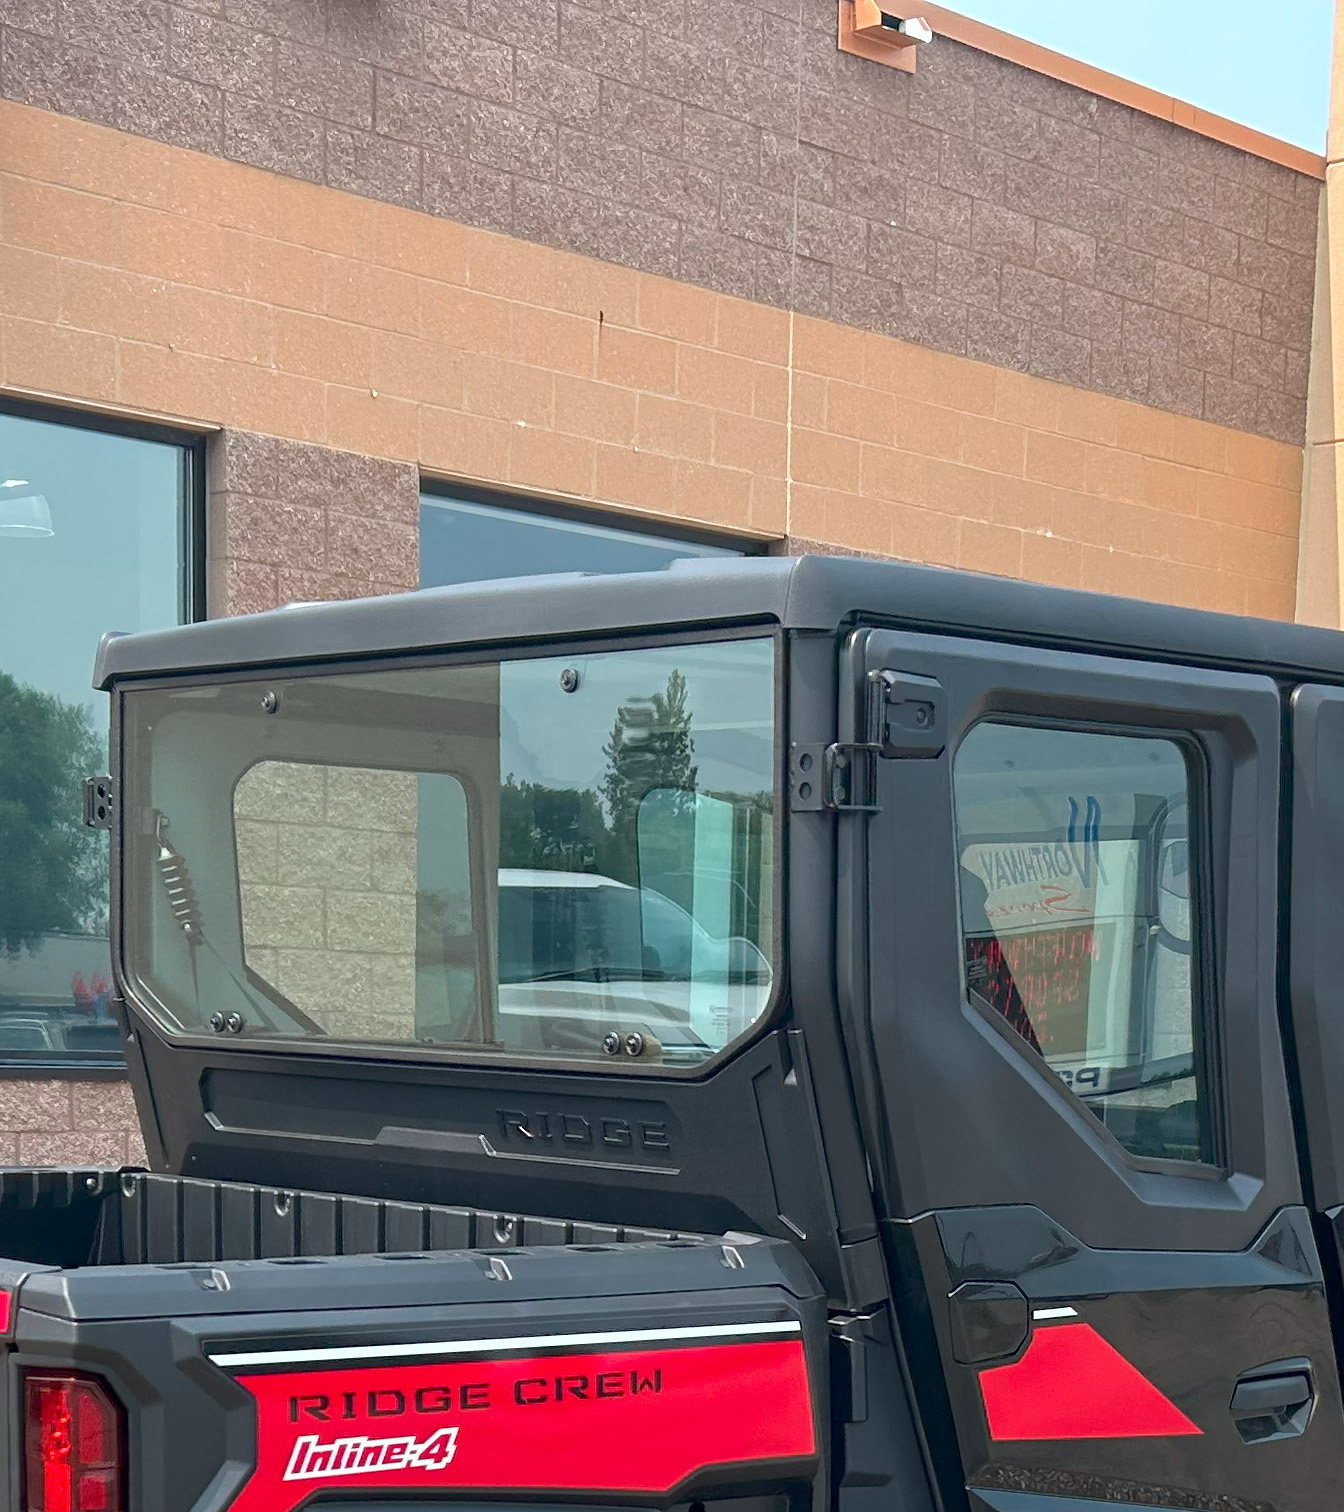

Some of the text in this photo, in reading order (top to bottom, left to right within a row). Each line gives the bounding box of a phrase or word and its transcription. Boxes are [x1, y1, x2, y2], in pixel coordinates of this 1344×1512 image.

[496, 1108, 671, 1150] RIDGE
[289, 1368, 663, 1424] RIDGE CREW
[283, 1426, 459, 1481] Inline-4
